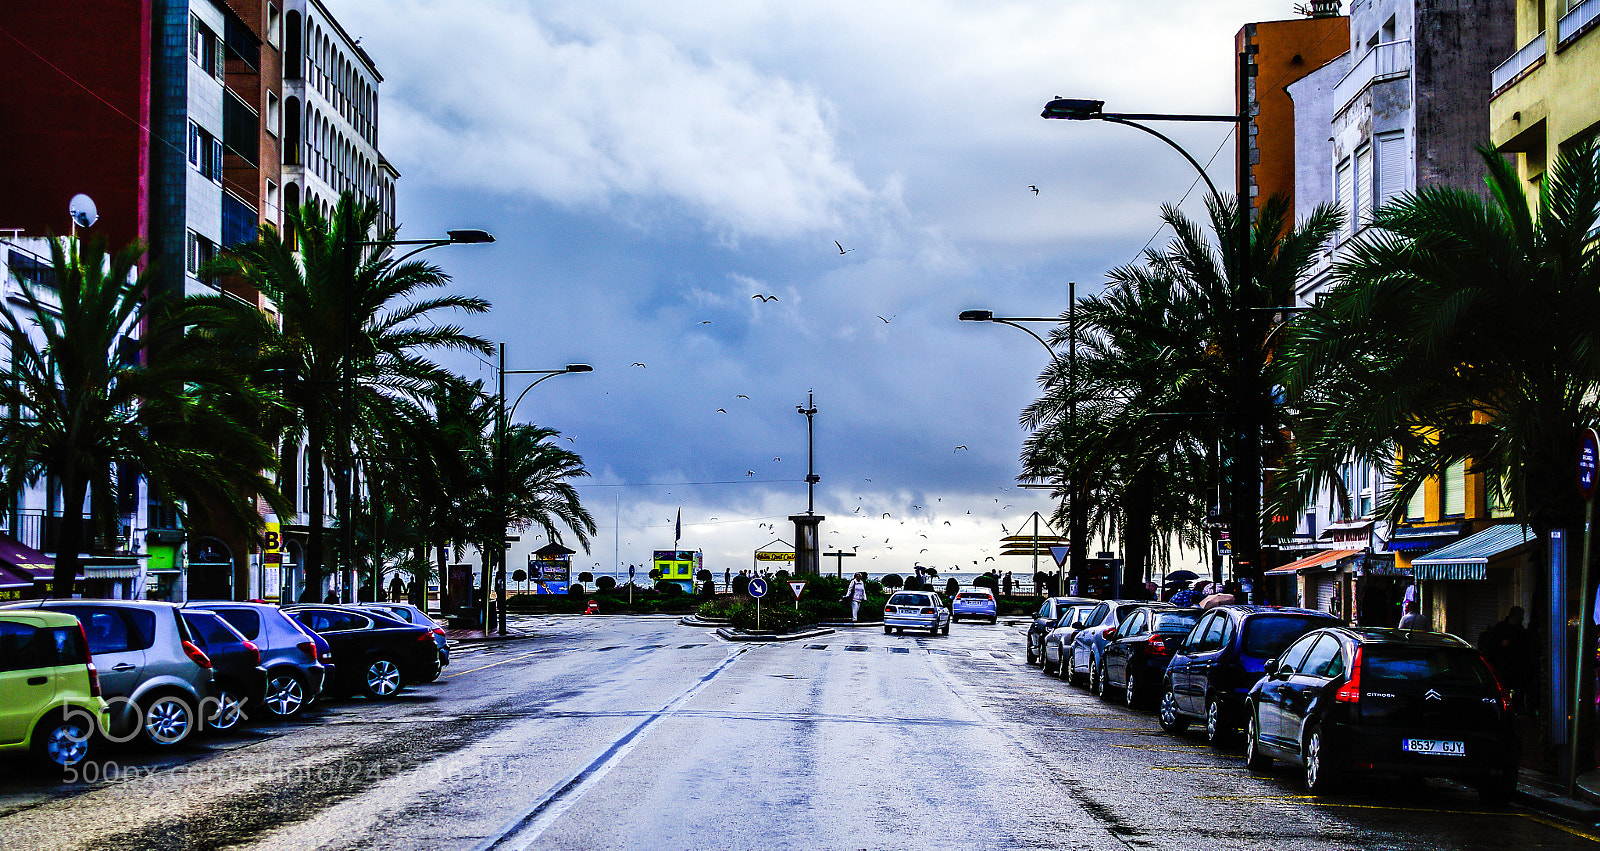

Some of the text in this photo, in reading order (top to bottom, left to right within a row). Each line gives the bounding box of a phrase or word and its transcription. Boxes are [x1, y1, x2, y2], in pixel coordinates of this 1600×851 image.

[265, 532, 279, 549] B
[1411, 740, 1462, 752] 8537 GJY
